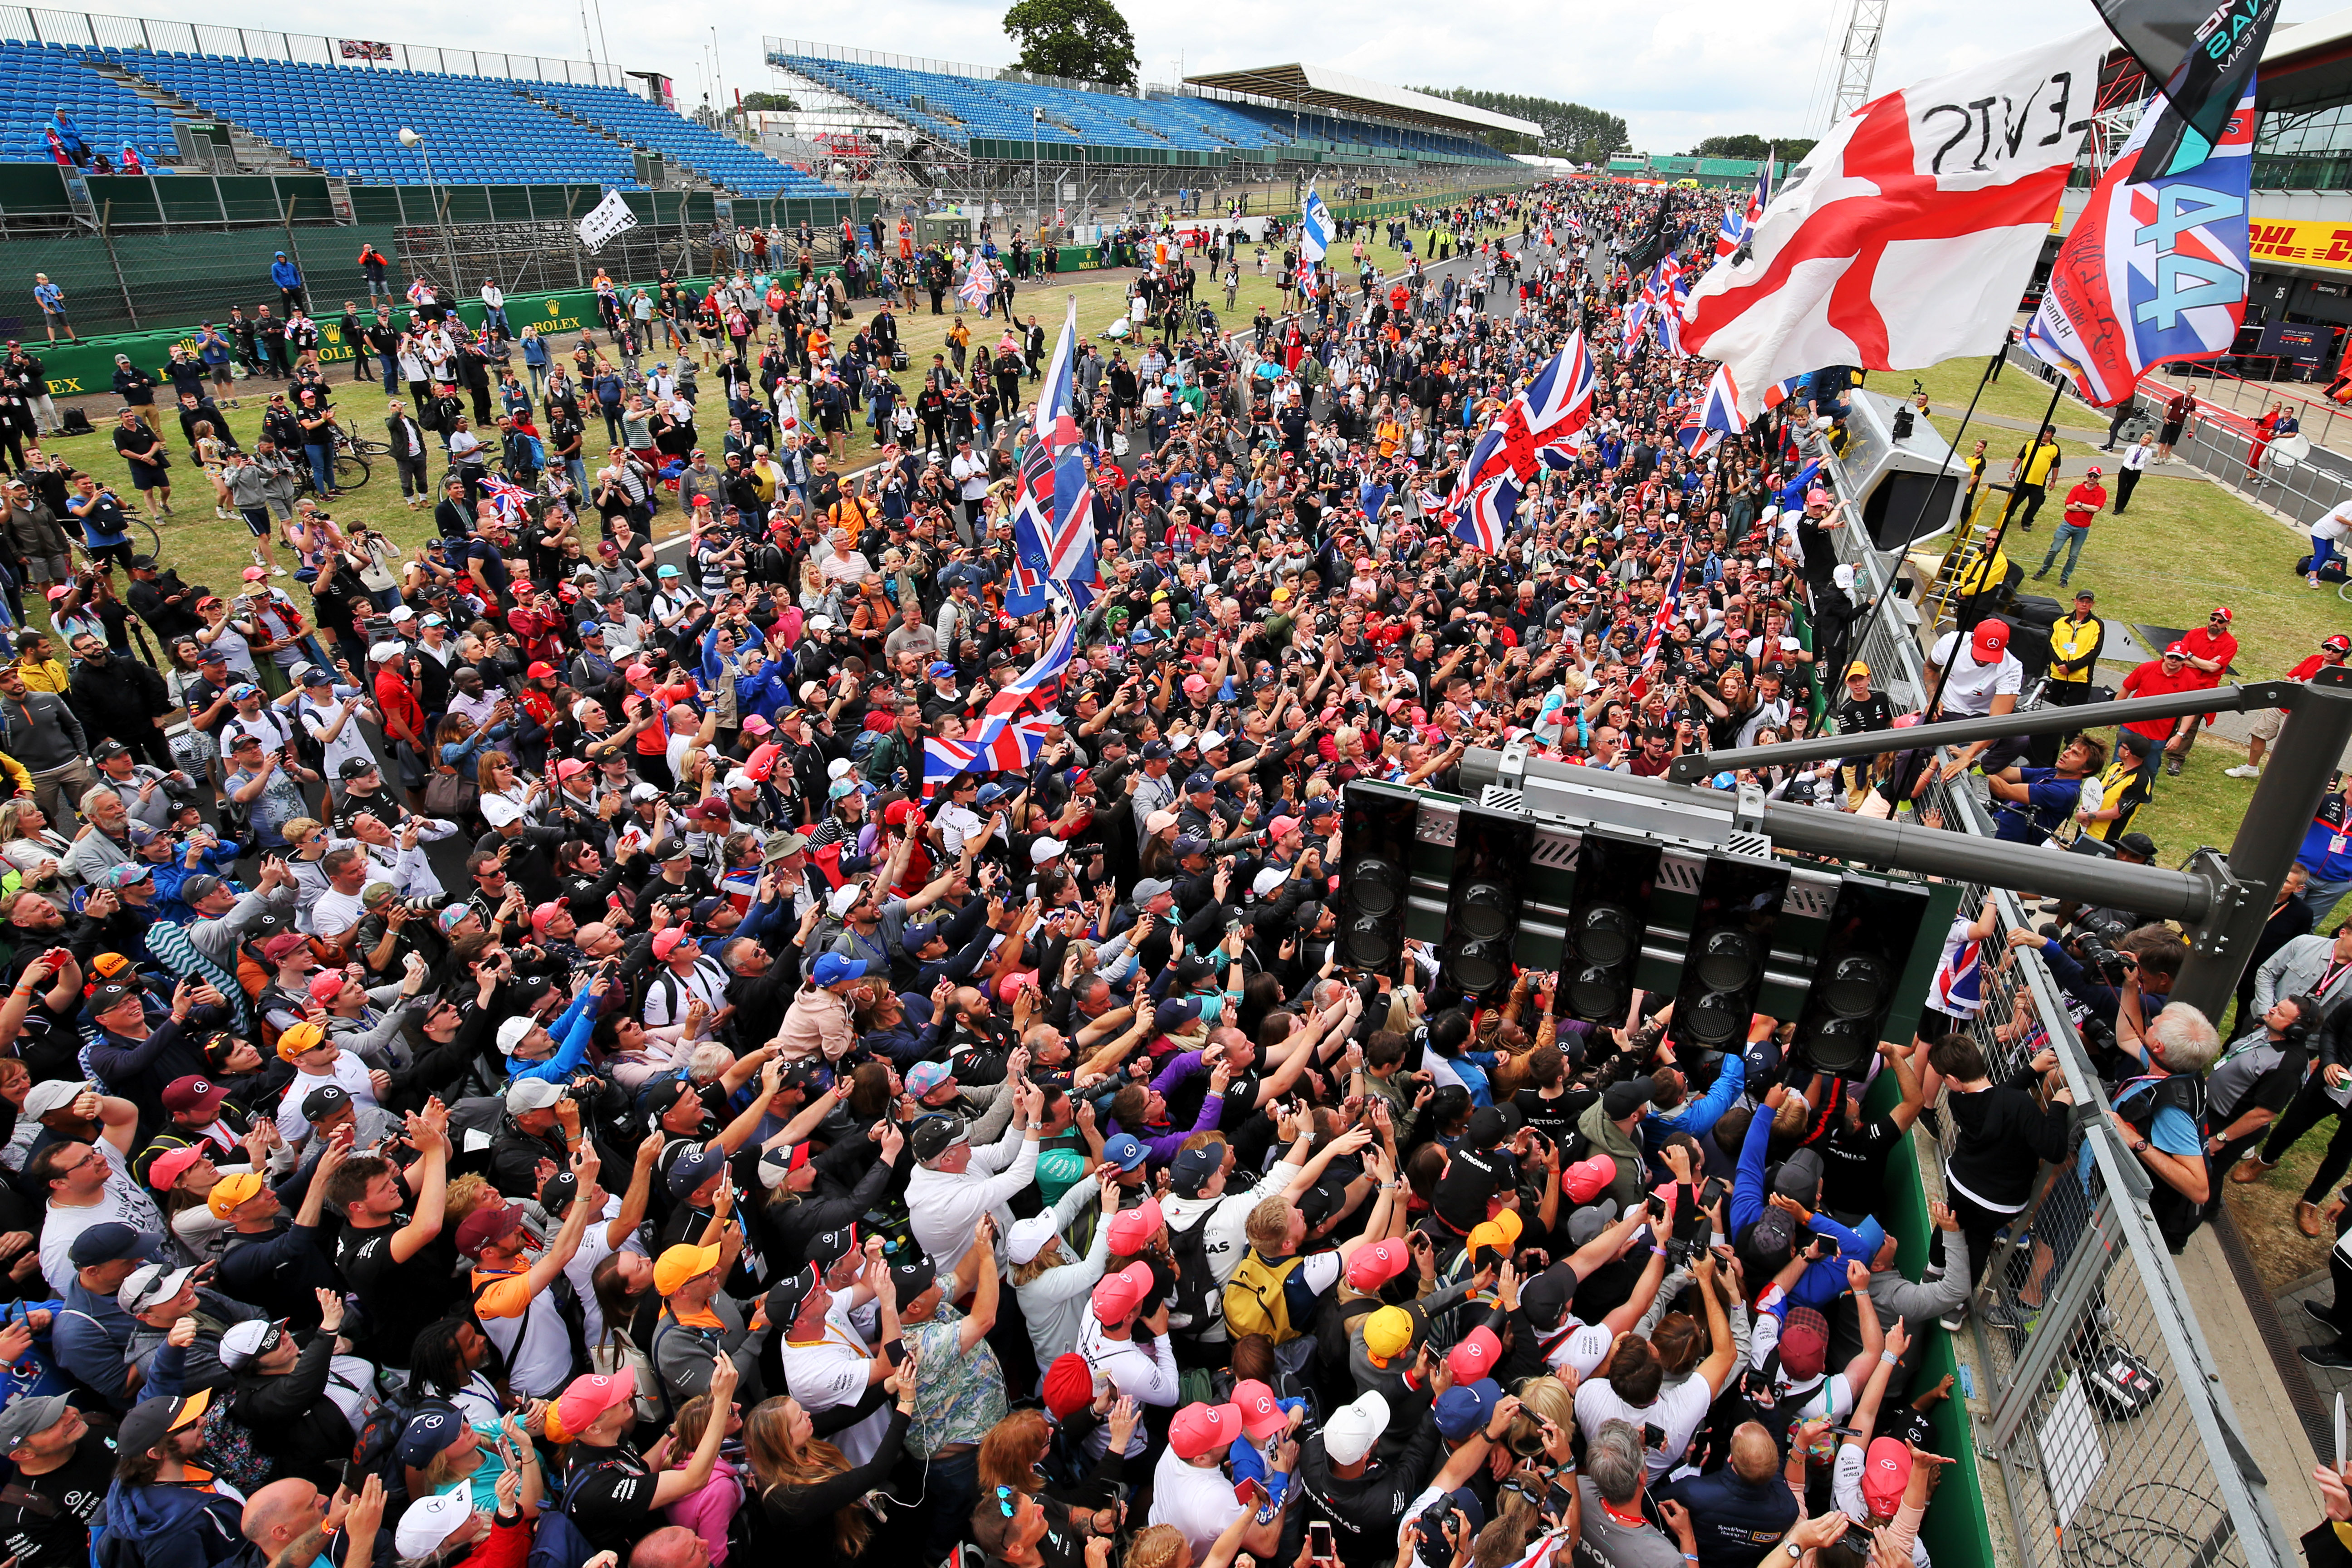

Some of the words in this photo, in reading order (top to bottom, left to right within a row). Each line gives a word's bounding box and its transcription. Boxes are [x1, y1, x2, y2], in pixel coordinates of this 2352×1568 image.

[2136, 183, 2244, 332] 44
[2053, 274, 2086, 327] #ForNiki
[2275, 287, 2285, 299] 25
[2043, 280, 2073, 339] #TeamLH
[533, 318, 581, 335] ROLEX
[928, 396, 941, 407] 44
[1705, 568, 1714, 577] NY
[2083, 789, 2100, 805] CLIMBING
[940, 816, 963, 832] PETRONA
[1048, 1159, 1064, 1174] EPSON
[1459, 1149, 1493, 1173] PETRONAS
[262, 1329, 279, 1349] 22
[833, 1374, 842, 1391] EPSON
[1916, 1415, 1929, 1426] 44
[456, 1489, 464, 1501] 44
[611, 1479, 628, 1498] EPSON
[86, 1496, 100, 1510] UBS
[1718, 1524, 1748, 1534] SportPesa
[1754, 1533, 1779, 1541] JCB
[1721, 1530, 1741, 1539] Racing
